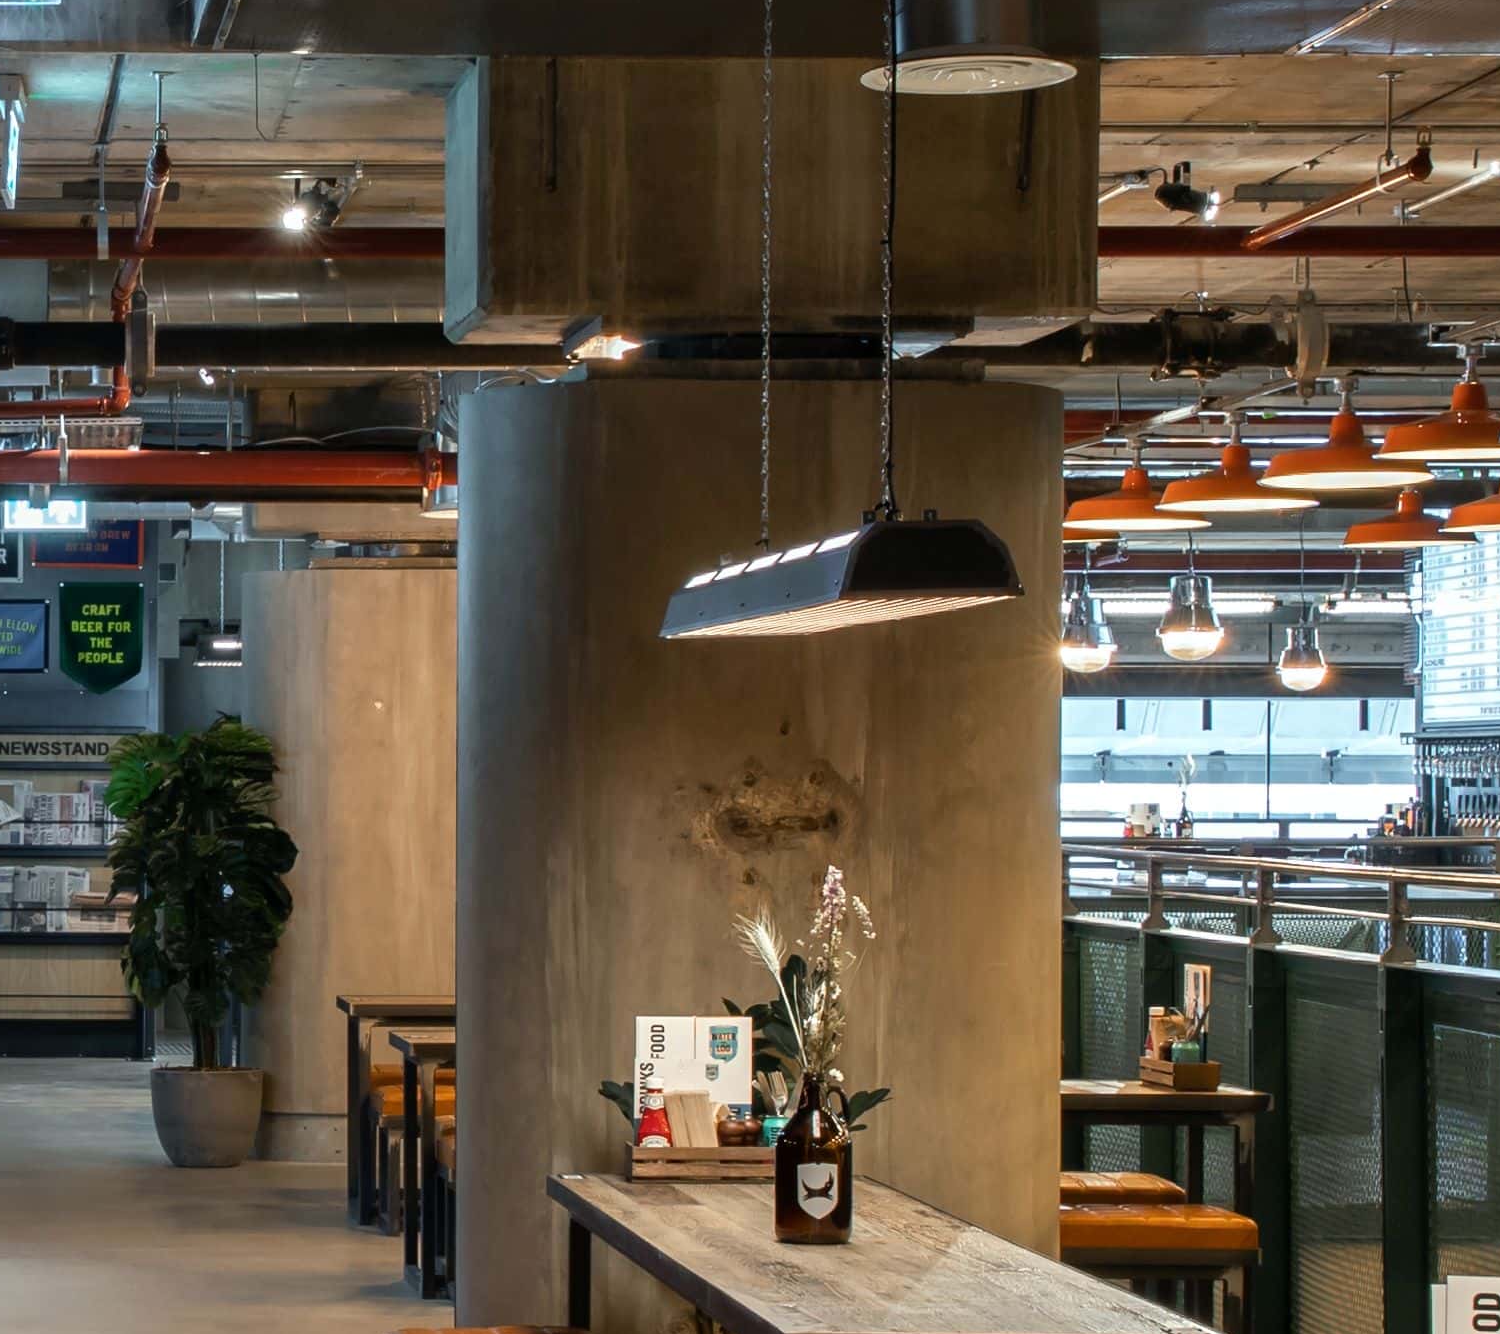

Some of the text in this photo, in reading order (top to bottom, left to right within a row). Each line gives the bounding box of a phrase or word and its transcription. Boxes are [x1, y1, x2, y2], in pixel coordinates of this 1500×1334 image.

[82, 604, 121, 616] CRAFT
[6, 618, 38, 634] ELLON
[71, 620, 132, 633] BEER FOR
[89, 637, 113, 649] THE
[78, 652, 124, 664] PEOPLE
[650, 1024, 665, 1059] FOOD
